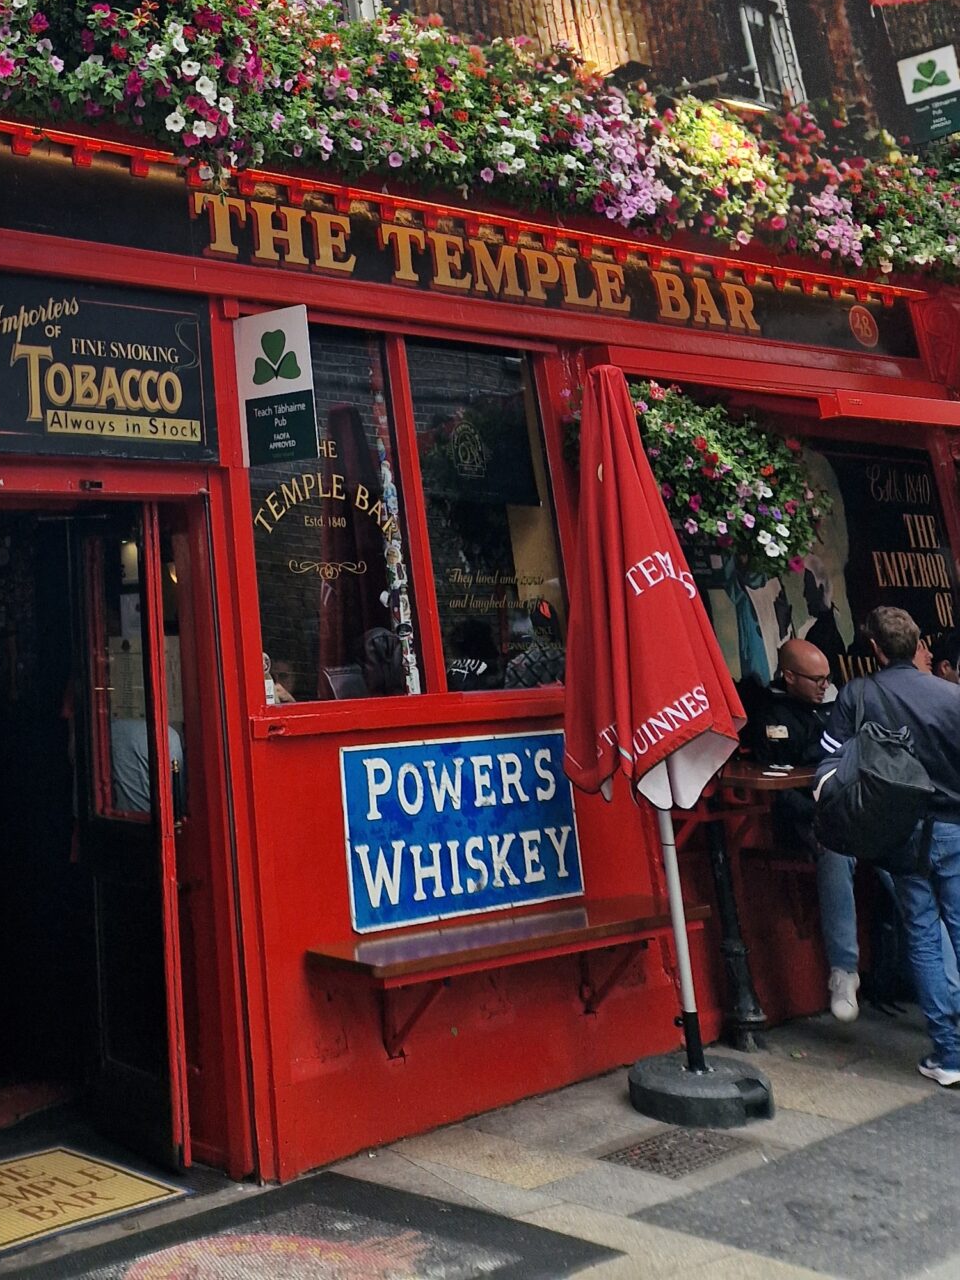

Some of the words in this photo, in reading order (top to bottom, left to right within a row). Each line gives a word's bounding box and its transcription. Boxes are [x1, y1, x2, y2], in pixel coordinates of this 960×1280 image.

[193, 192, 357, 273] THE
[379, 223, 632, 312] TEMPLE
[650, 270, 761, 332] BAR
[44, 324, 62, 338] OF
[71, 337, 107, 356] FINE
[110, 342, 180, 364] SMOKING
[10, 343, 184, 423] TOBACCO
[50, 410, 115, 433] Always
[125, 419, 141, 434] in
[149, 418, 199, 439] Stock
[254, 405, 273, 418] Teach
[274, 417, 287, 427] Pub
[269, 440, 296, 450] APPROVED
[318, 440, 338, 458] HE
[904, 472, 931, 505] 1840
[254, 472, 346, 534] TEMPLE
[355, 484, 399, 542] BAR
[304, 516, 326, 527] Estd.
[328, 517, 347, 528] 1840
[903, 514, 940, 548] THE
[872, 551, 951, 589] EMPEROR
[449, 594, 468, 609] and
[470, 594, 507, 614] laughed
[935, 592, 955, 628] OF
[632, 684, 710, 763] UINNES
[362, 747, 557, 821] POWER'S
[354, 825, 573, 908] WHISKEY
[18, 1189, 116, 1222] BAR
